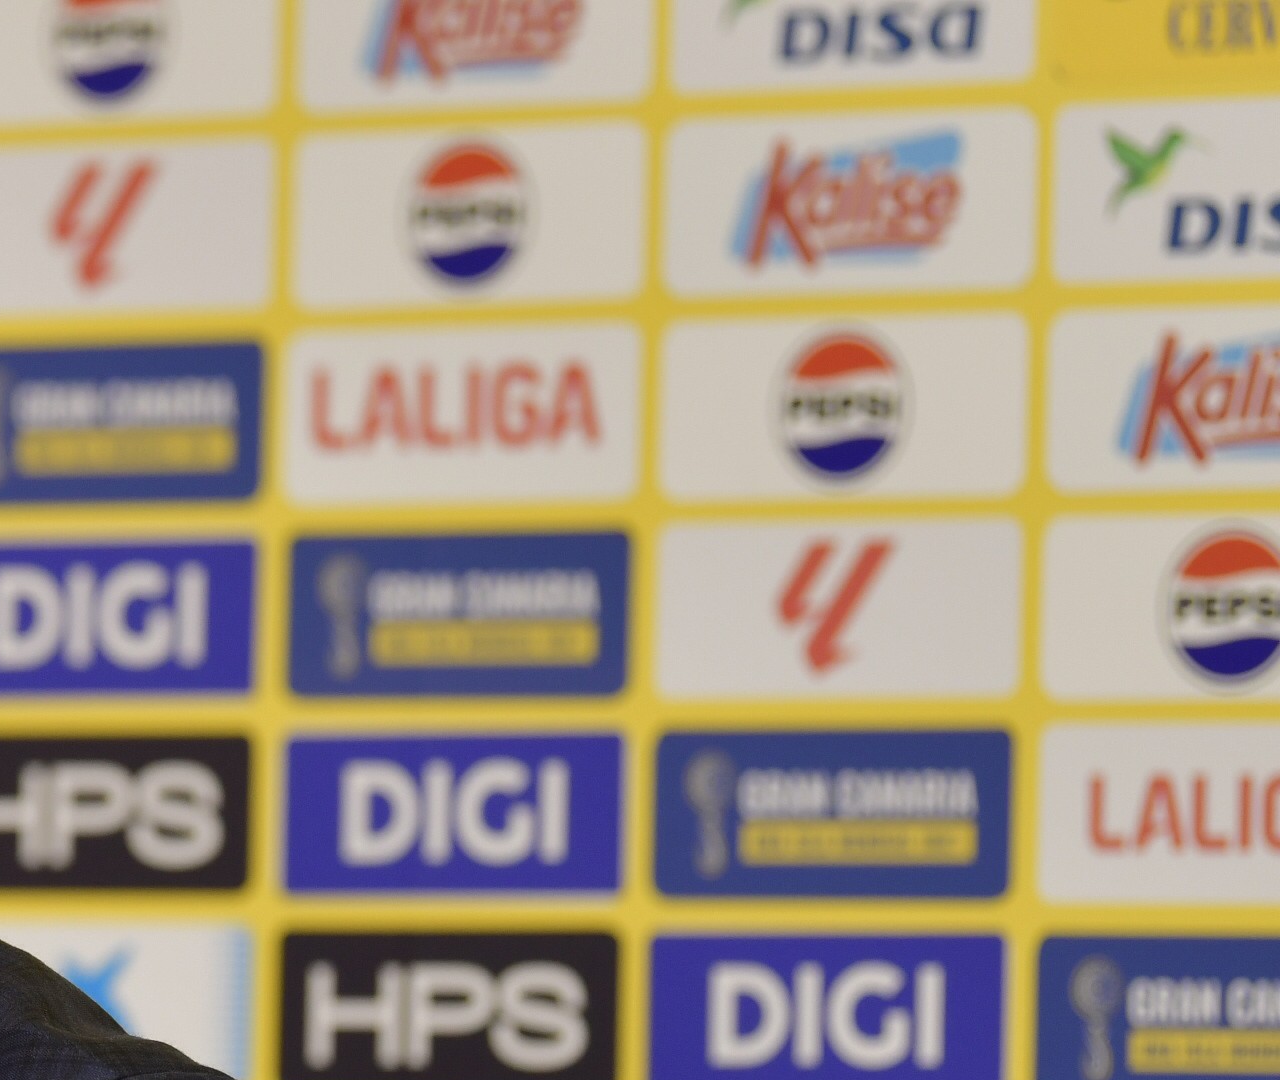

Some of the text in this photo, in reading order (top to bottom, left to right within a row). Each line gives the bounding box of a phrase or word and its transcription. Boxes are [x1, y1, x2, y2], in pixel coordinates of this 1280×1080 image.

[309, 360, 600, 453] LALIGA
[339, 757, 570, 867] DIGI
[303, 960, 589, 1073] HPS
[706, 960, 946, 1071] DIGI
